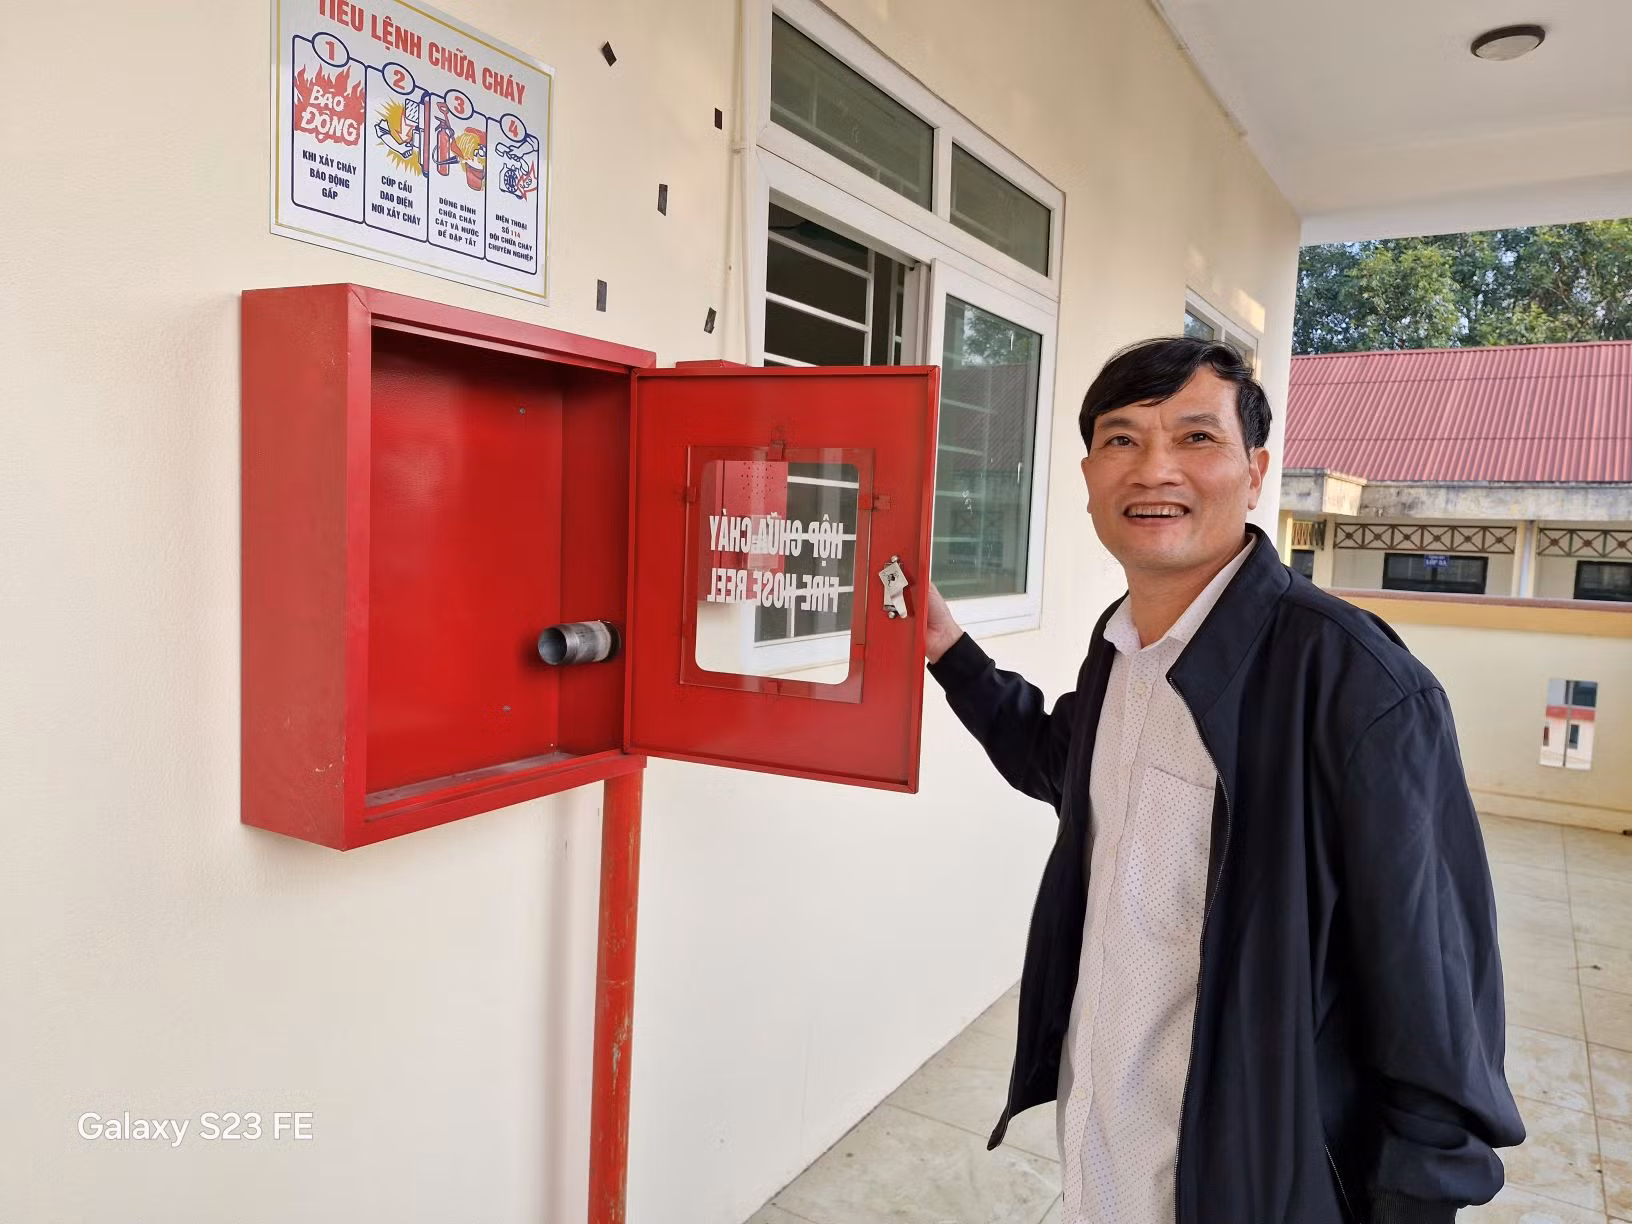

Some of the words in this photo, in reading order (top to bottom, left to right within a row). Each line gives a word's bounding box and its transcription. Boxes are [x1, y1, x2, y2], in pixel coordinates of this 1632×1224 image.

[325, 40, 335, 62] 1
[371, 14, 422, 60] LỆNH
[428, 42, 476, 84] CHỮA
[482, 68, 525, 105] CHÁY
[393, 70, 405, 90] 2
[454, 96, 465, 115] 3
[301, 106, 357, 141] ĐỘNG
[509, 120, 519, 137] 4
[302, 149, 316, 160] KHI
[319, 154, 334, 168] XẢY
[337, 161, 357, 175] CHÁY
[310, 167, 326, 182] BÁO
[328, 174, 350, 189] ĐỘNG
[382, 176, 396, 187] CÚP
[322, 187, 338, 200] GẤP
[380, 190, 394, 202] DAO
[396, 196, 413, 209] ĐIỆN
[372, 203, 384, 215] NƠI
[387, 207, 400, 219] XẢY
[403, 213, 421, 226] CHÁY
[439, 208, 456, 219] CHỮA
[459, 215, 476, 226] CHÁY
[496, 214, 509, 224] ĐIỆN
[511, 219, 527, 230] THOẠI
[435, 218, 448, 227] CÁT
[451, 223, 459, 231] VÀ
[461, 226, 479, 237] NƯỚC
[490, 233, 499, 242] ĐỘI
[501, 237, 516, 247] CHỮA
[518, 242, 532, 252] CHÁY
[489, 243, 511, 255] CHUYÊN
[513, 250, 533, 262] NGHIỆP
